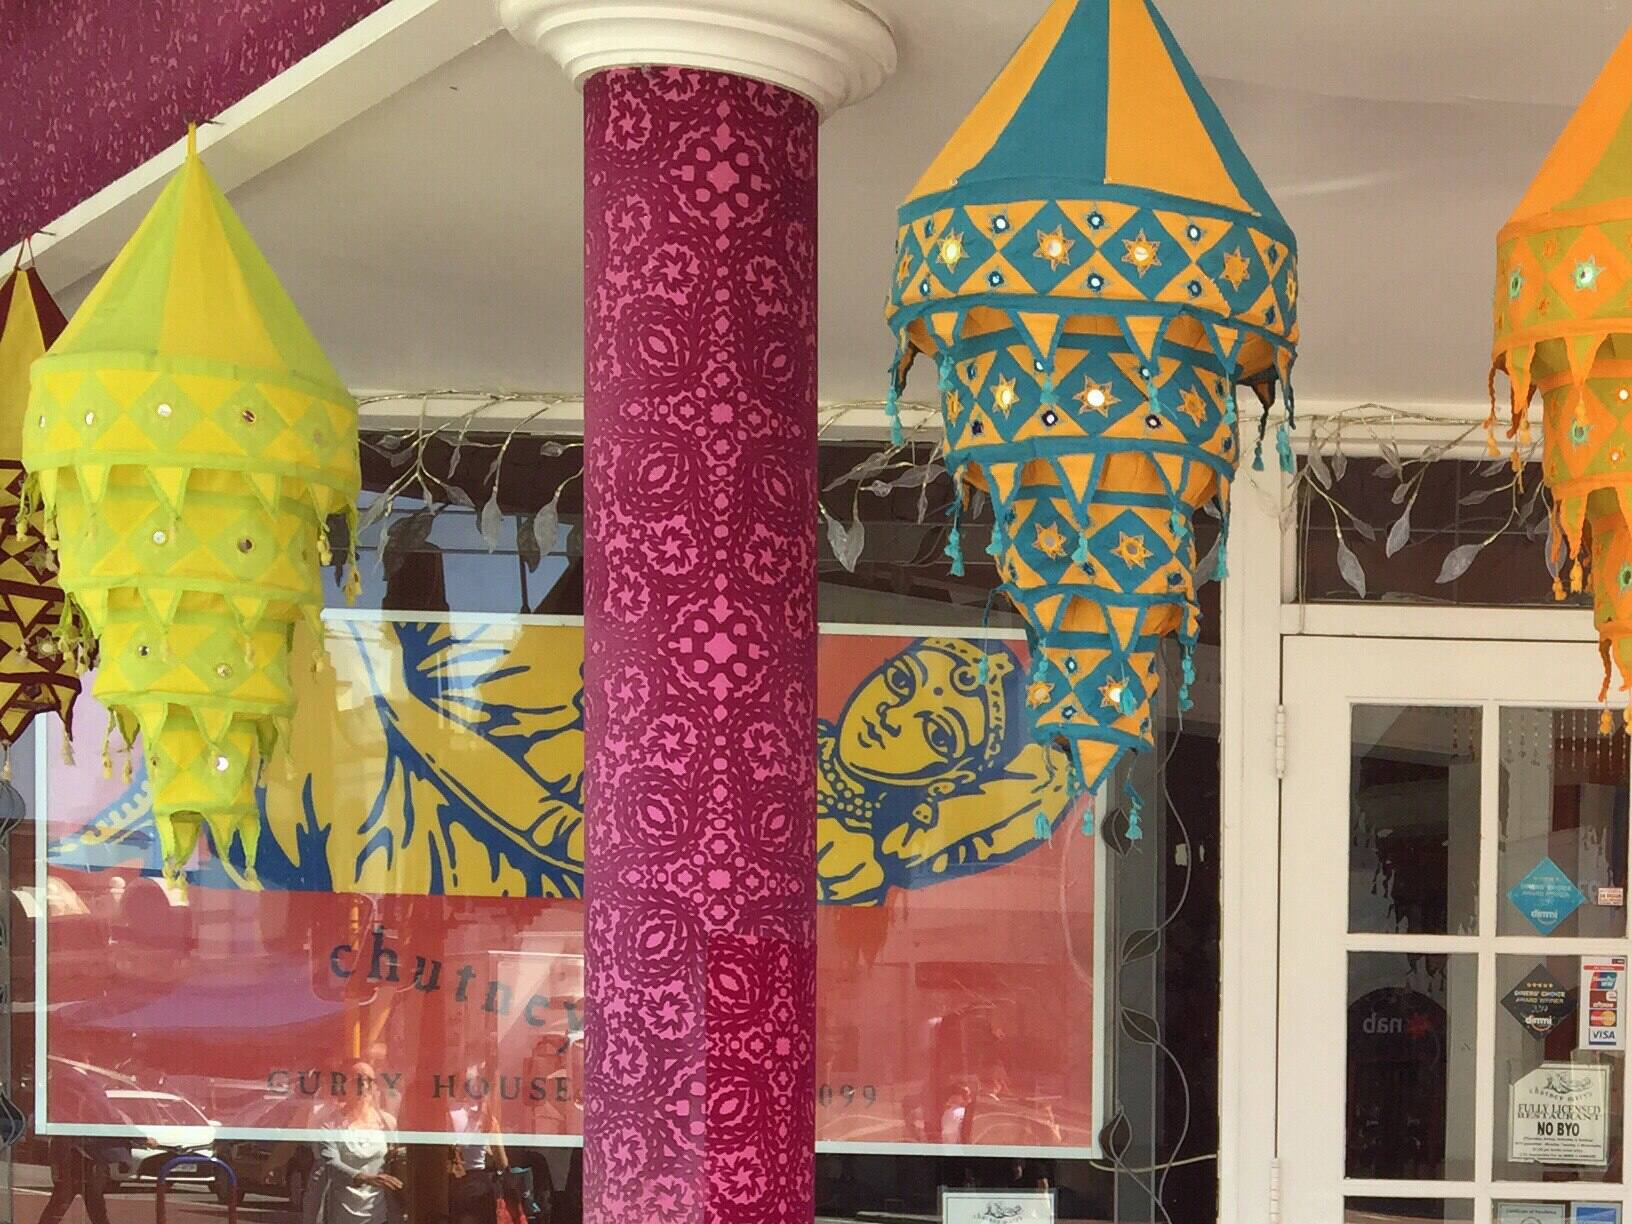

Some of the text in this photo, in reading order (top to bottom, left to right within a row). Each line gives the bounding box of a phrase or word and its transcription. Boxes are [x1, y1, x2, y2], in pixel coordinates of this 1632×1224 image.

[1593, 1031, 1615, 1039] VISA
[431, 1074, 573, 1101] HOUSE
[818, 1084, 877, 1108] 099
[1518, 1103, 1601, 1115] FULLY LICENSED
[1537, 1122, 1580, 1136] NO BYO
